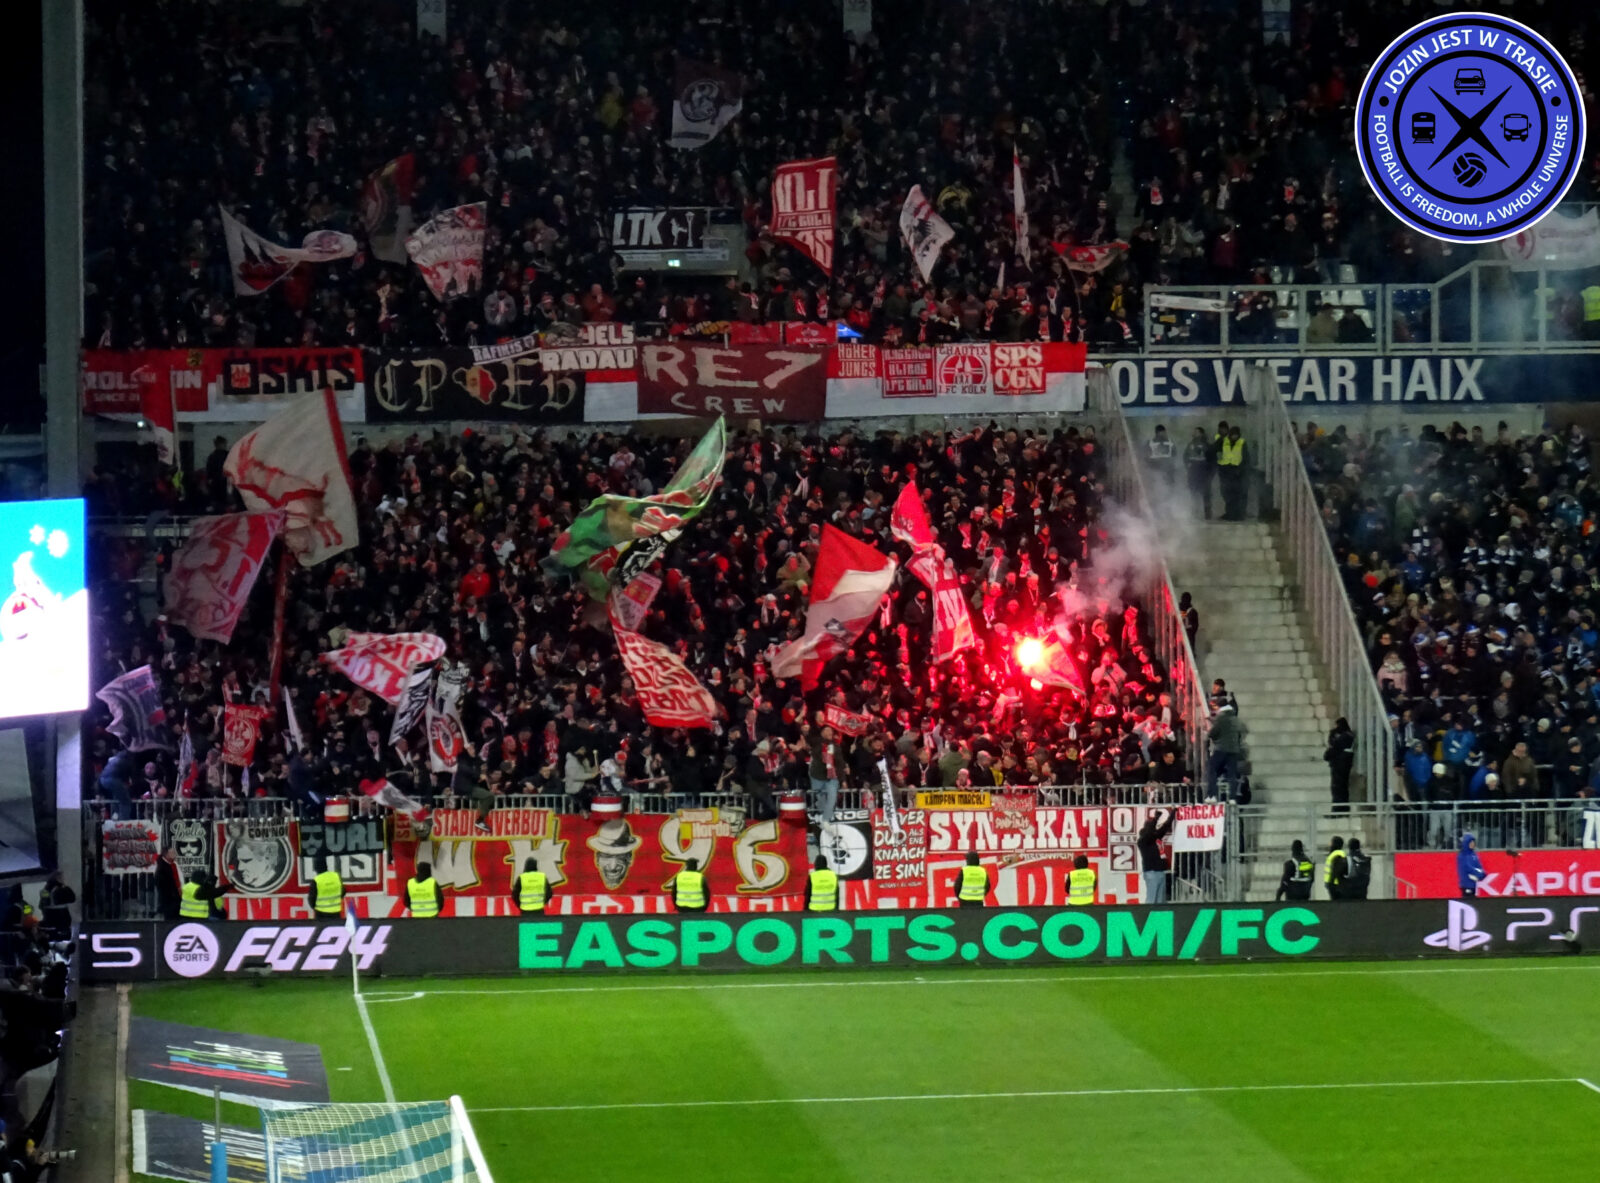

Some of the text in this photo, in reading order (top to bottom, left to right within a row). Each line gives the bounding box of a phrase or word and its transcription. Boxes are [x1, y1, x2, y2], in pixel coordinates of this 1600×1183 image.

[612, 211, 667, 246] LTK
[542, 350, 634, 371] RADAU
[994, 345, 1042, 367] SPS
[838, 361, 876, 377] JUNGS
[994, 367, 1045, 389] CGN
[1372, 358, 1485, 401] HAIX
[1187, 824, 1215, 838] KÖLN
[875, 860, 925, 880] ZE SIN!
[174, 935, 209, 953] EA
[517, 908, 1322, 968] EASPORTS.COM/FC
[80, 933, 142, 968] 5
[173, 953, 210, 963] SPORTS
